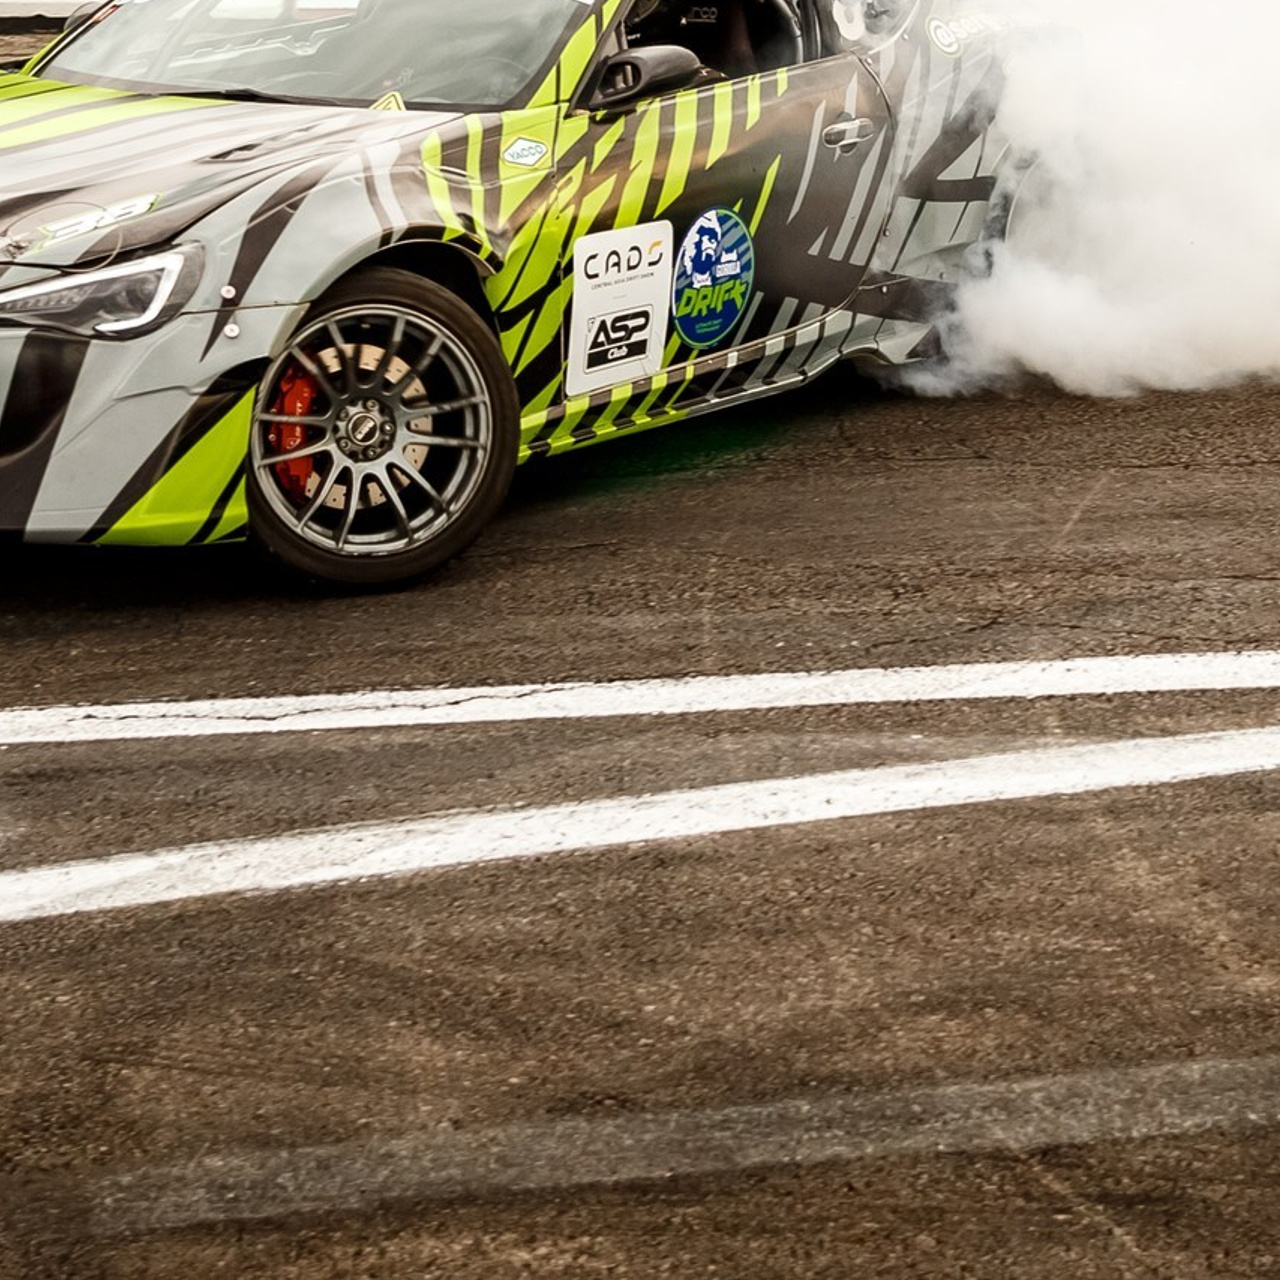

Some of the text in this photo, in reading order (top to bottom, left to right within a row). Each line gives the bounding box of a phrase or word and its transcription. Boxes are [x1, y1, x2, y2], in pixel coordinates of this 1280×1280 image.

[583, 240, 664, 280] CADS
[676, 280, 748, 318] DRIFT
[588, 310, 650, 352] ASP
[607, 347, 629, 360] Club
